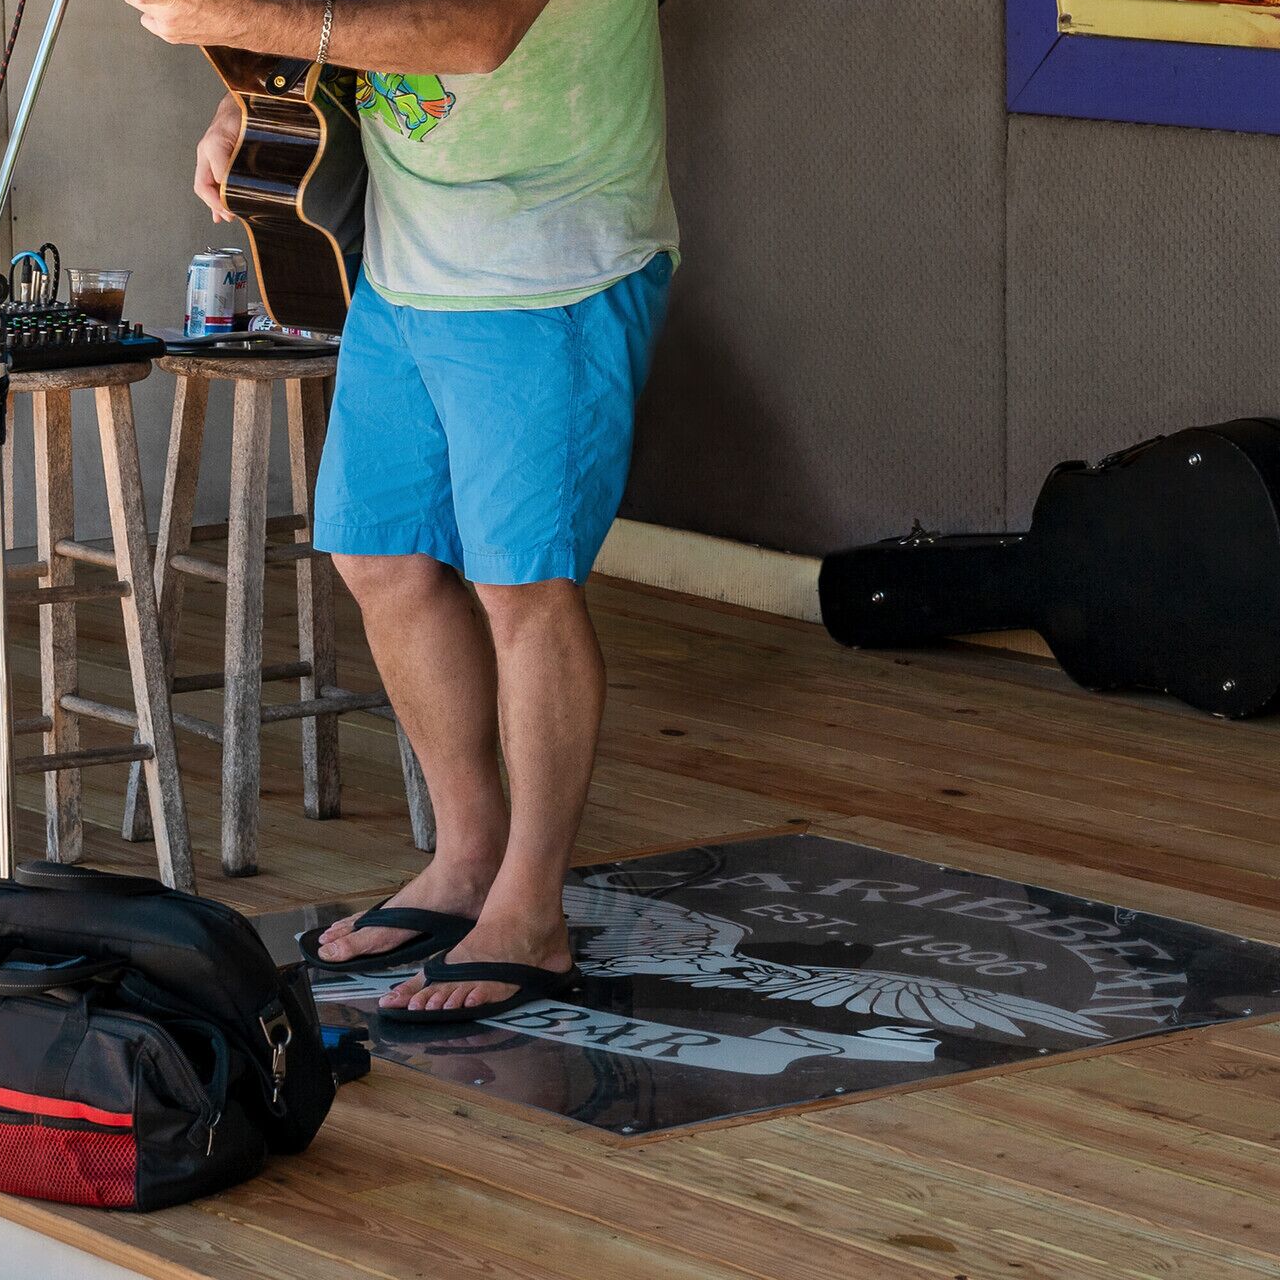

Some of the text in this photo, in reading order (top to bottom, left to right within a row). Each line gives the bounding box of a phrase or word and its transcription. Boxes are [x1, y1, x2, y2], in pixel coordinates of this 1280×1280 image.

[583, 870, 1188, 1024] CARIBBEAN
[742, 904, 1047, 976] EST. 1996
[500, 1007, 721, 1058] BAR
